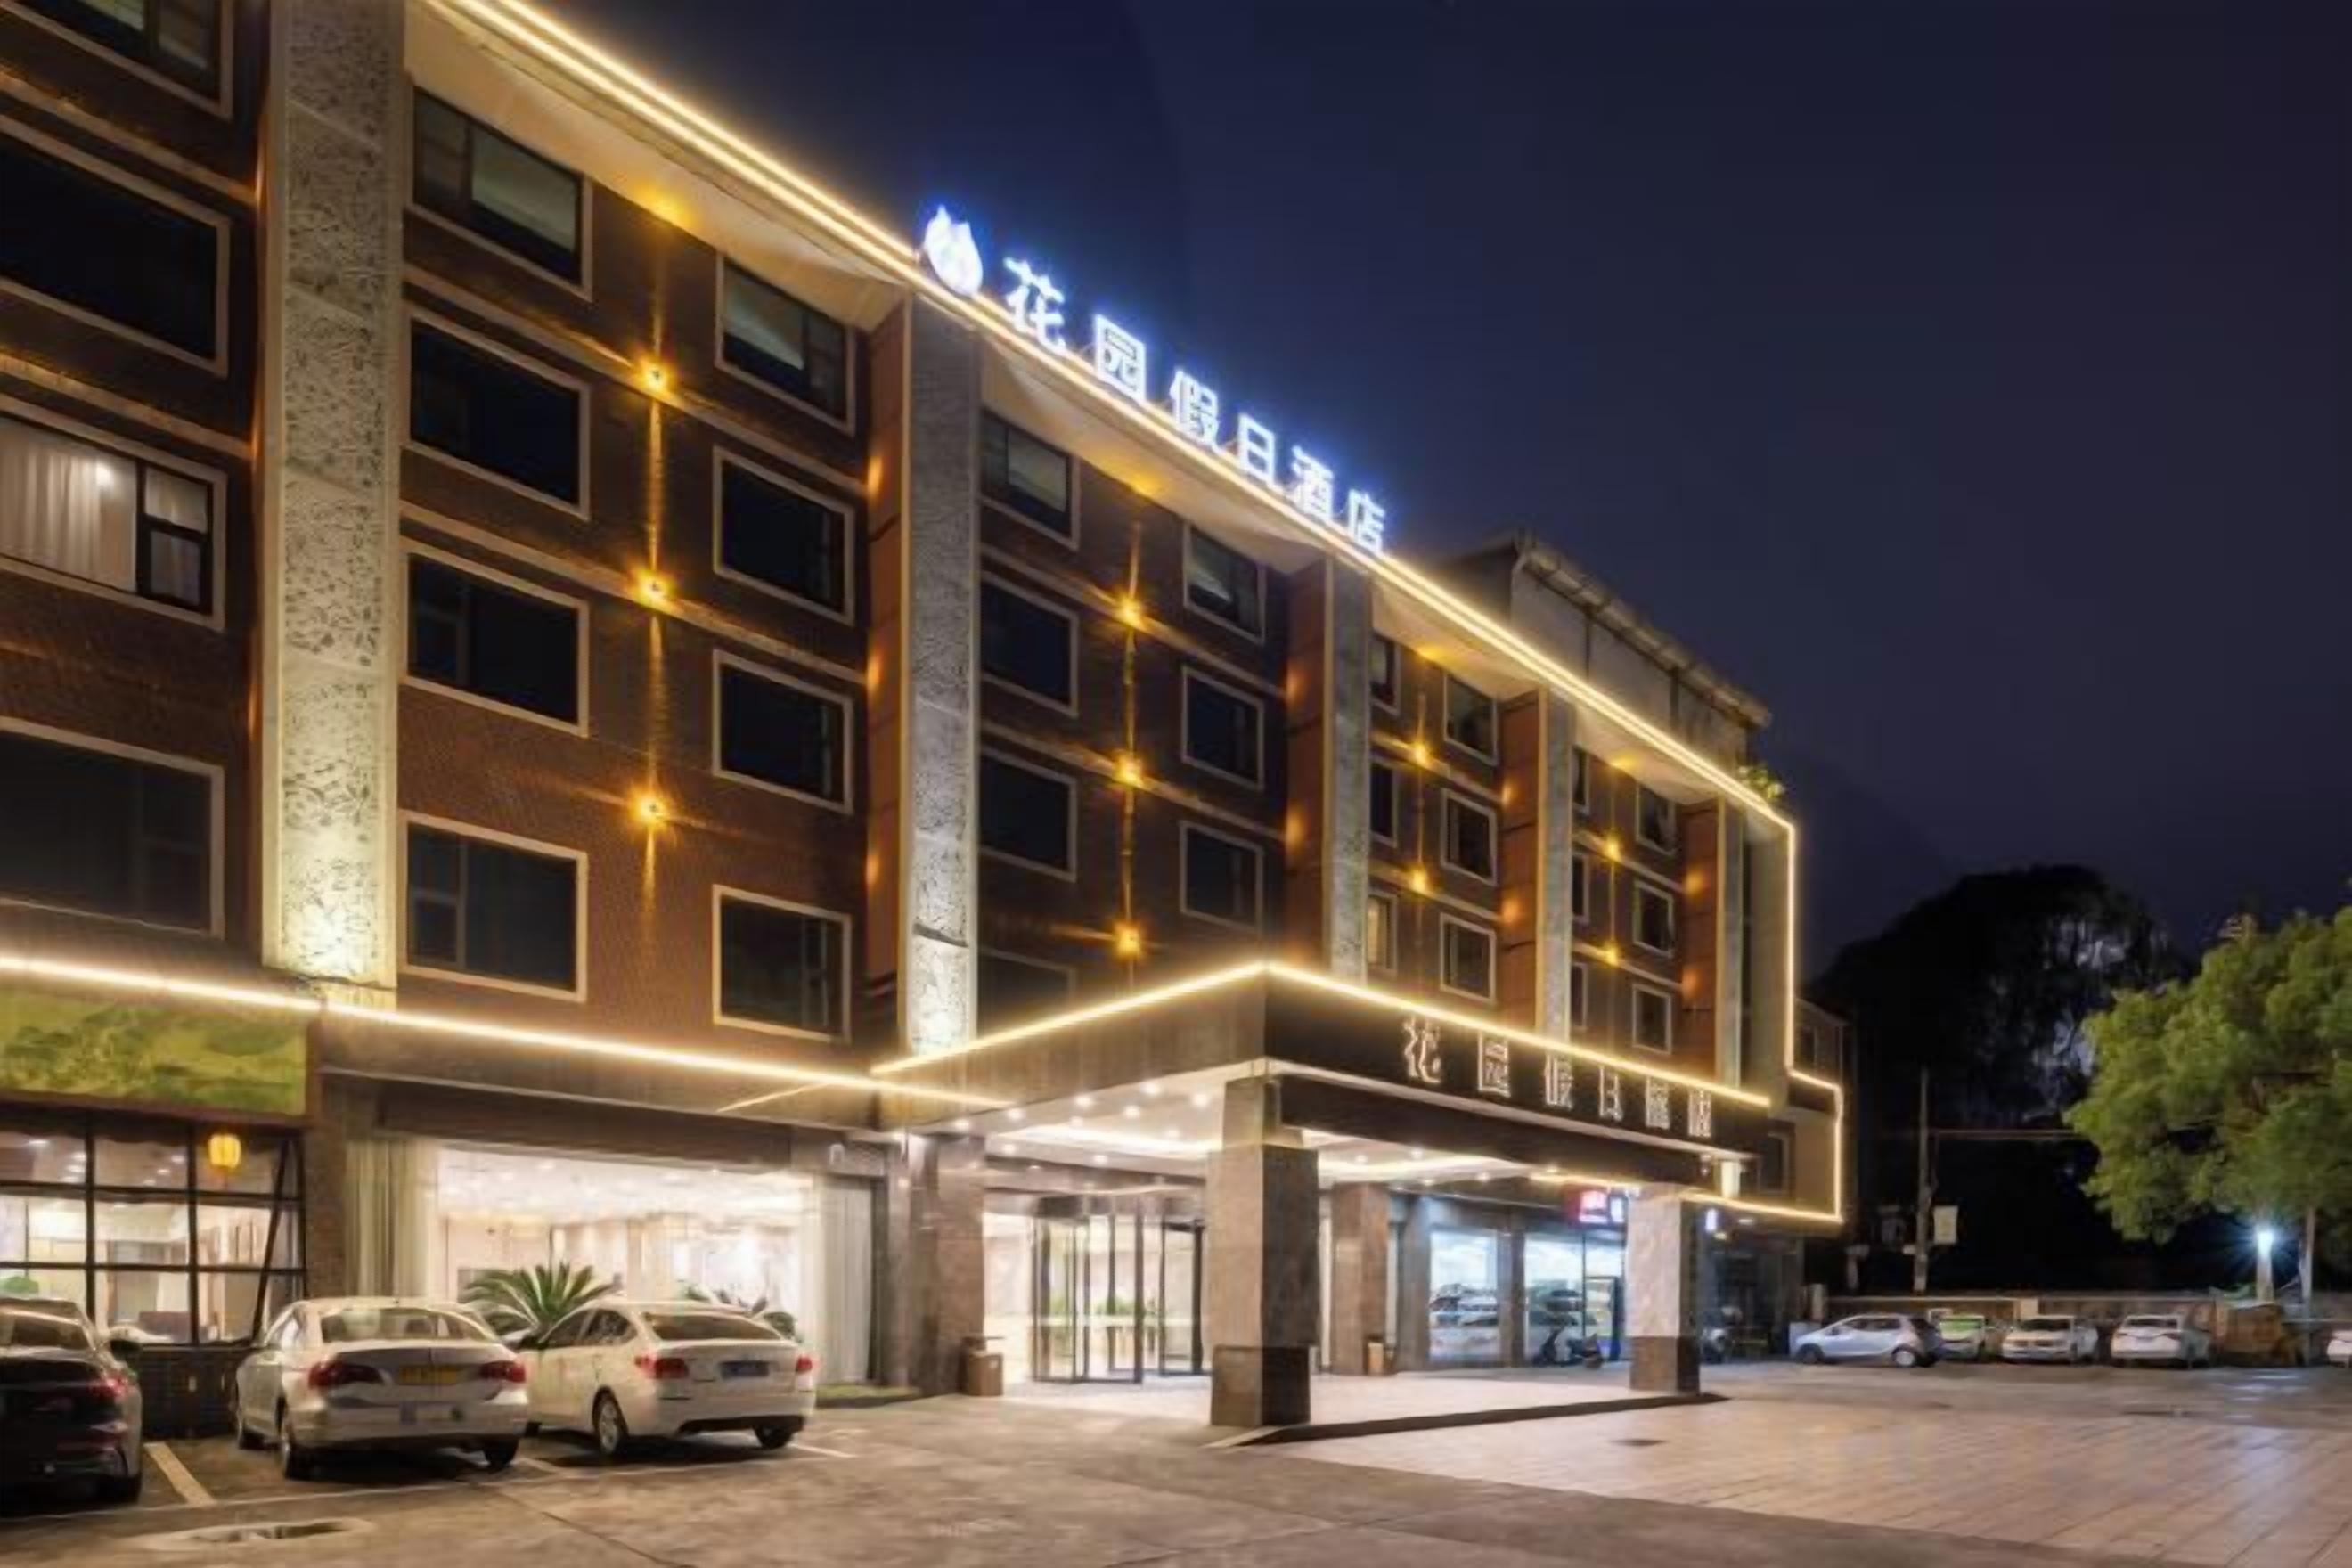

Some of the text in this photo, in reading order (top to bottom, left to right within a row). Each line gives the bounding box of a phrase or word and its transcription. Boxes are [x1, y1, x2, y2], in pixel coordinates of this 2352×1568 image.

[1004, 257, 1385, 557] 花园假日酒店
